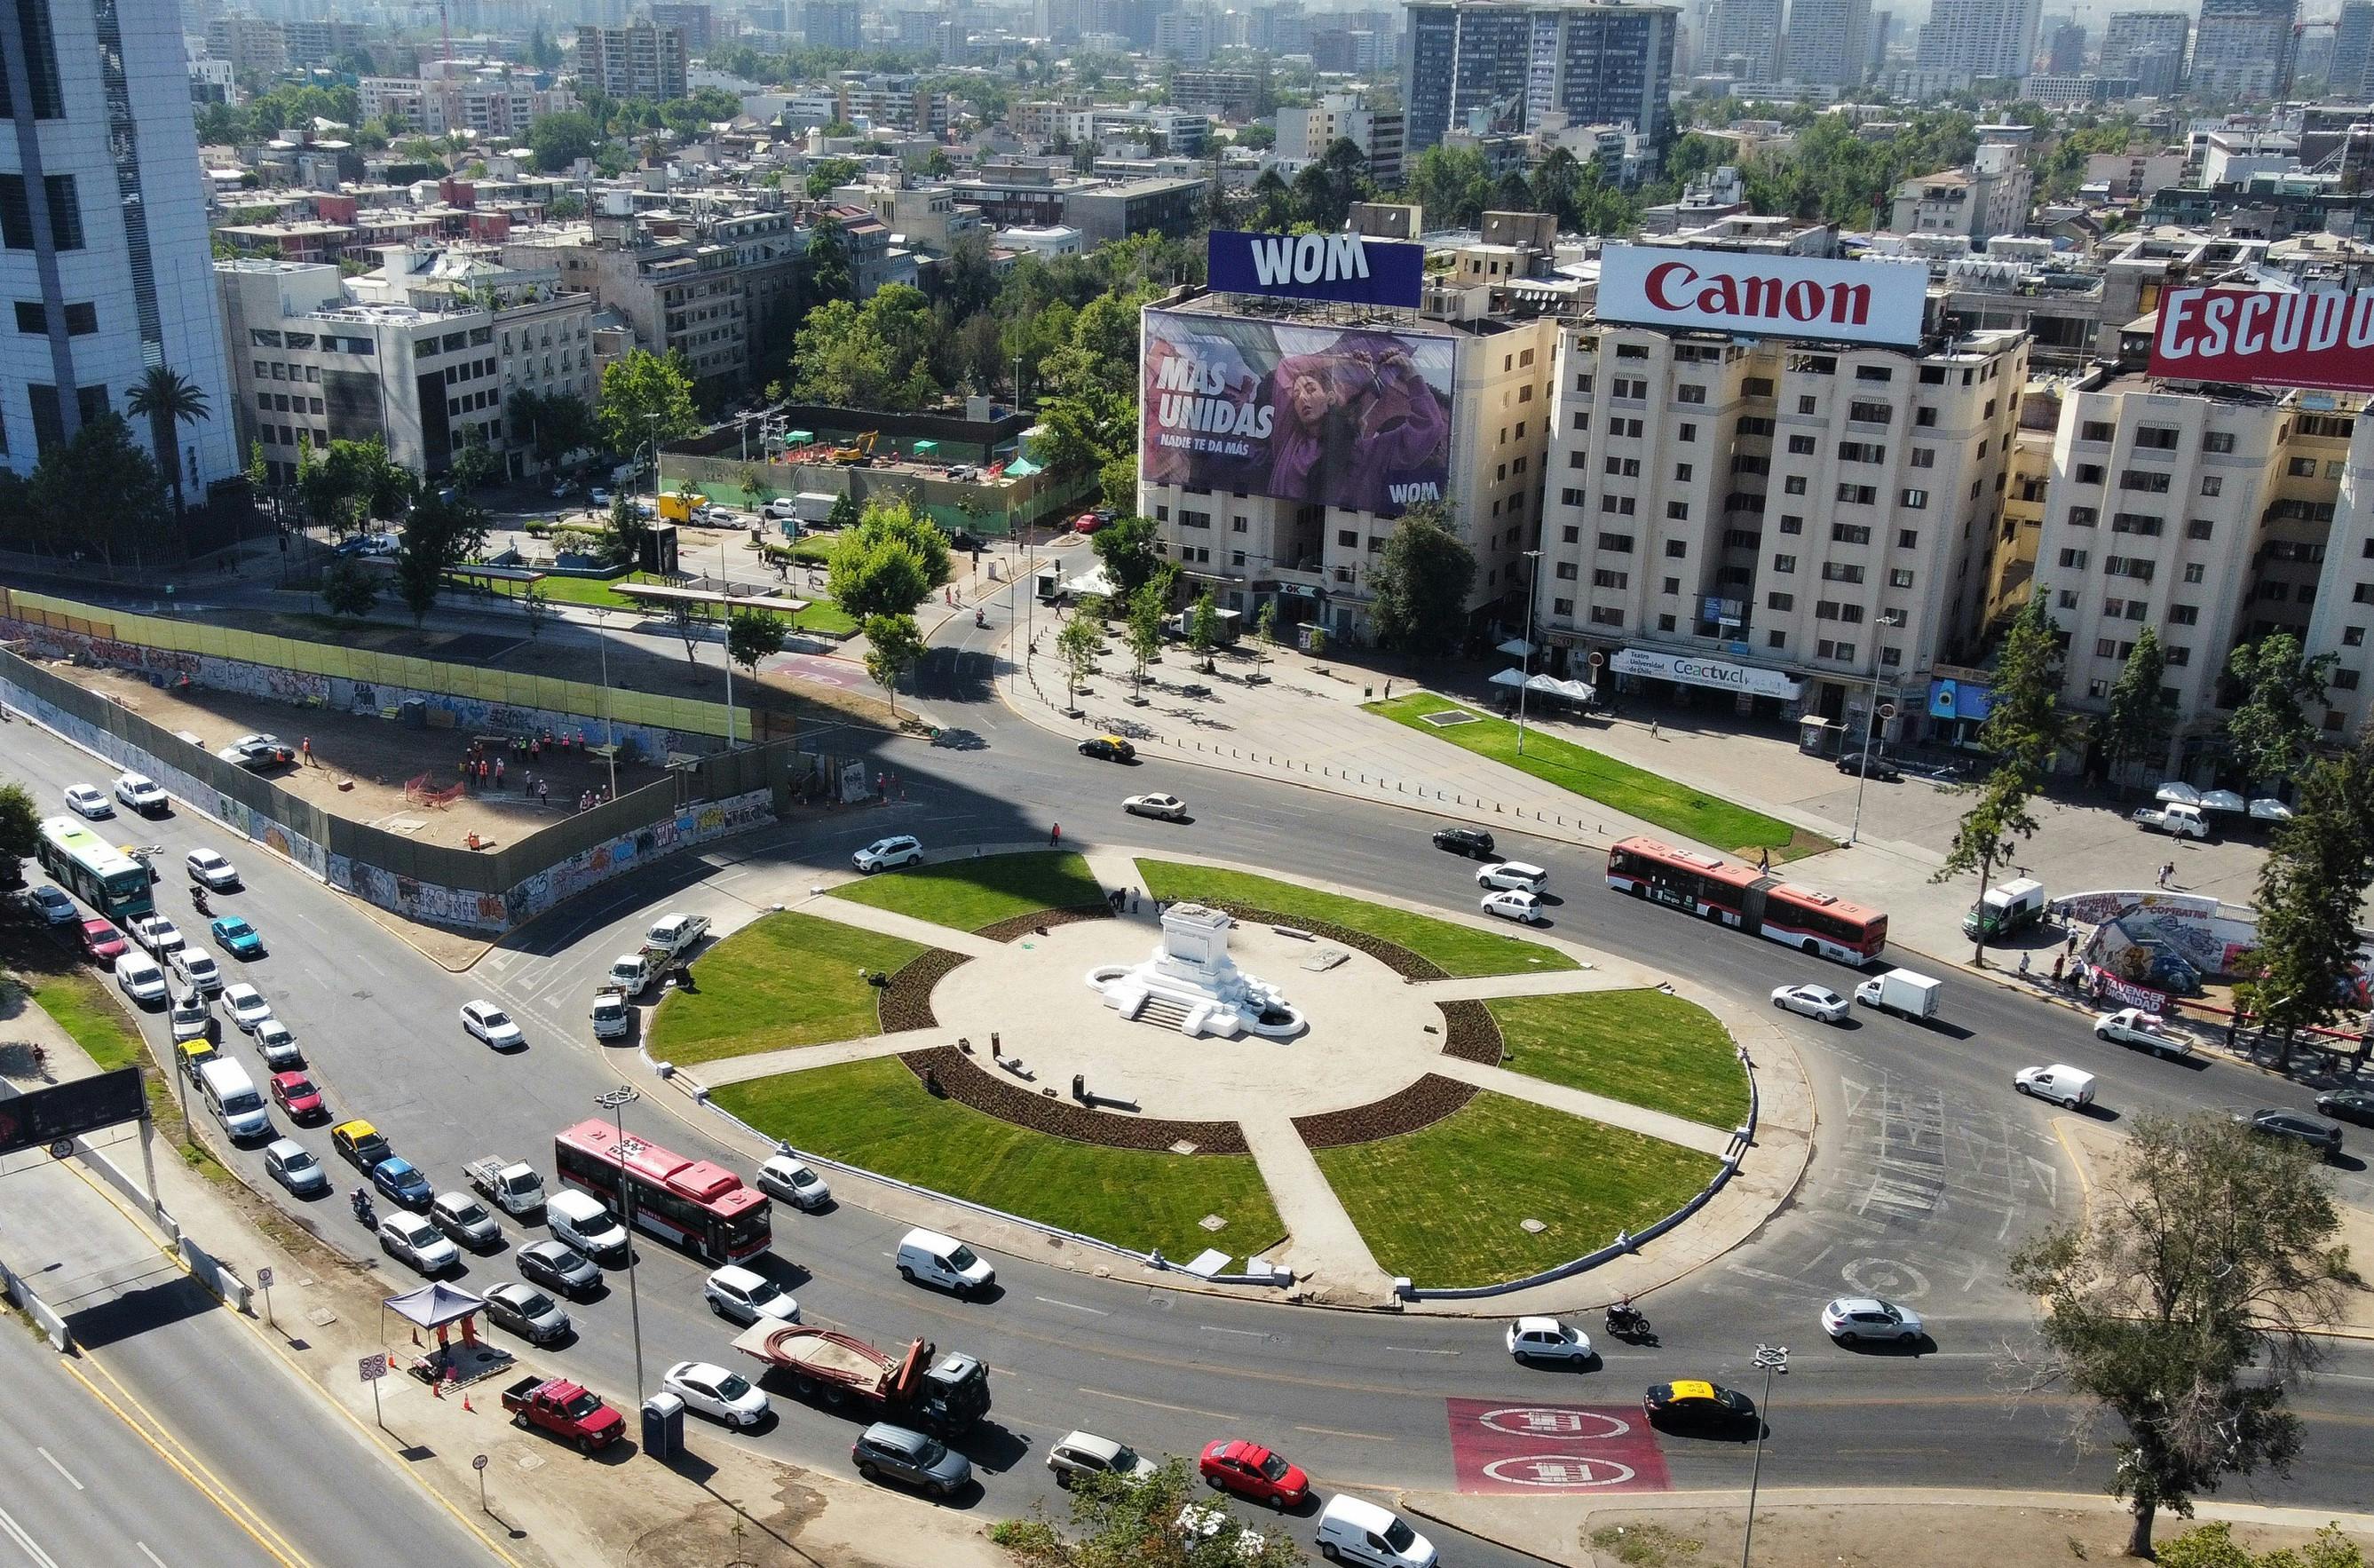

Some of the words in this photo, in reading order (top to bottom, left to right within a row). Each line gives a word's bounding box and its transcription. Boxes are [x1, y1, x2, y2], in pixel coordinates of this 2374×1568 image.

[1251, 232, 1369, 286] WOM
[1644, 261, 1872, 325] Canon
[1157, 352, 1227, 395] MÁS
[1159, 395, 1275, 440] UNIDAS
[1160, 433, 1191, 450] NADIE
[1194, 437, 1206, 451] TE
[1208, 438, 1223, 454] DA
[1223, 439, 1248, 456] MÁS
[1389, 481, 1439, 504] WOM
[1286, 584, 1300, 593] OK
[2105, 987, 2161, 1012] DIGNIDAD
